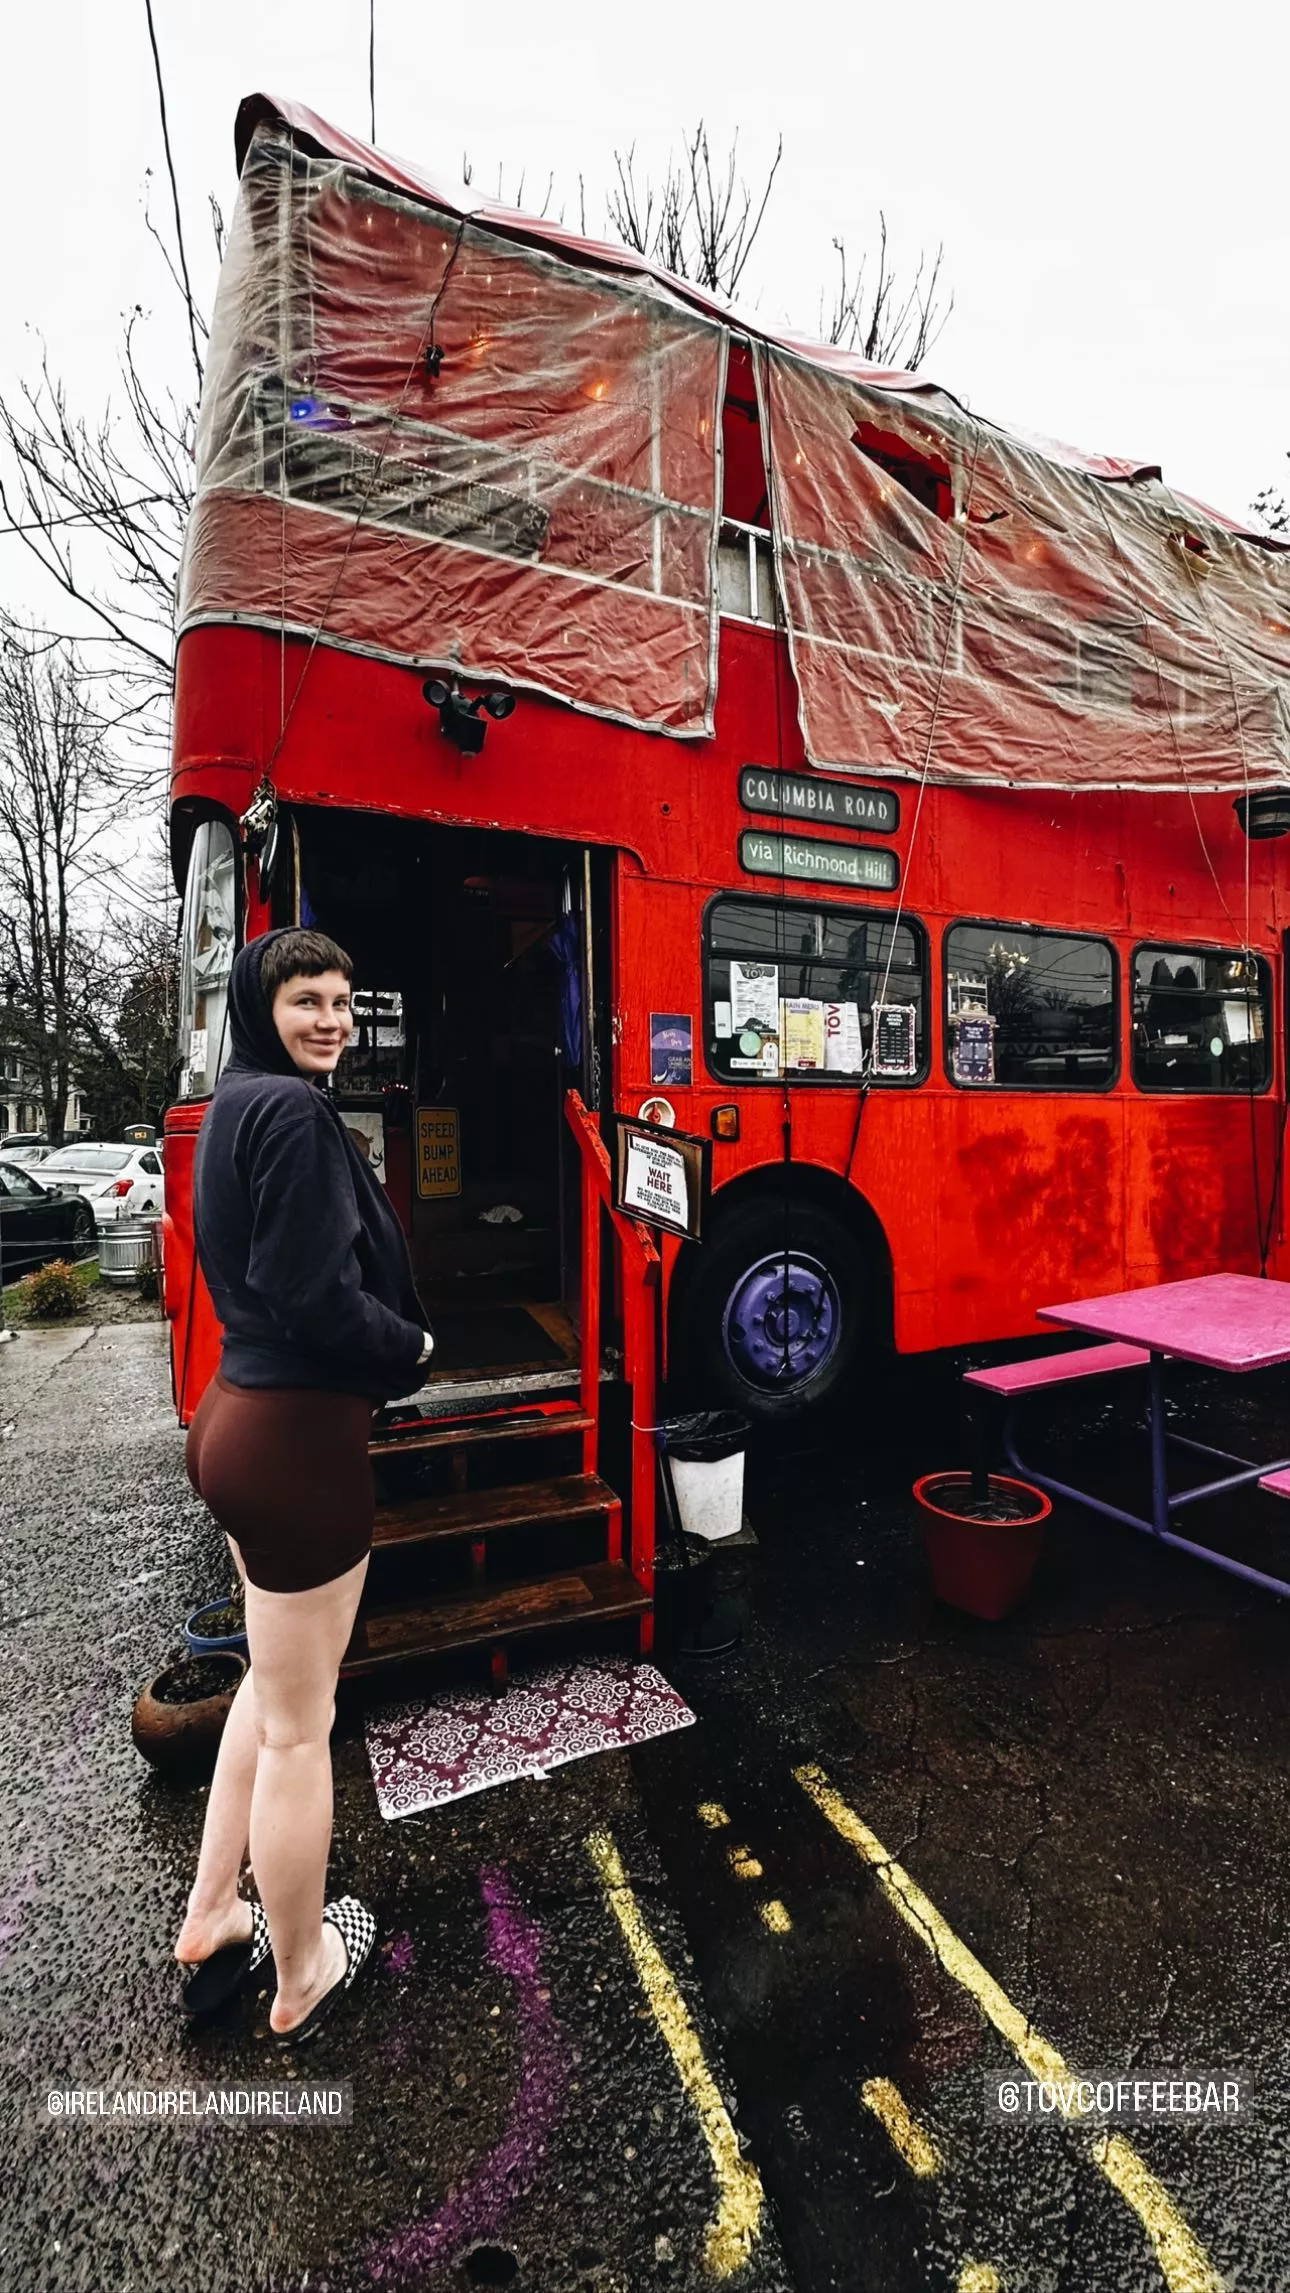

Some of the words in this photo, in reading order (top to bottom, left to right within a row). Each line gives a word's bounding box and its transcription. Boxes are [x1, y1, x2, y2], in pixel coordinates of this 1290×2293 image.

[746, 777, 835, 812] COLUMBIA
[845, 796, 888, 819] ROAD
[749, 841, 773, 860] via
[784, 845, 858, 876] Richmond
[865, 860, 887, 881] Hill
[421, 1123, 455, 1138] SPEED
[423, 1145, 454, 1161] BUMP
[422, 1167, 457, 1184] AHEAD
[648, 1166, 671, 1182] WAIT
[647, 1176, 672, 1194] HERE
